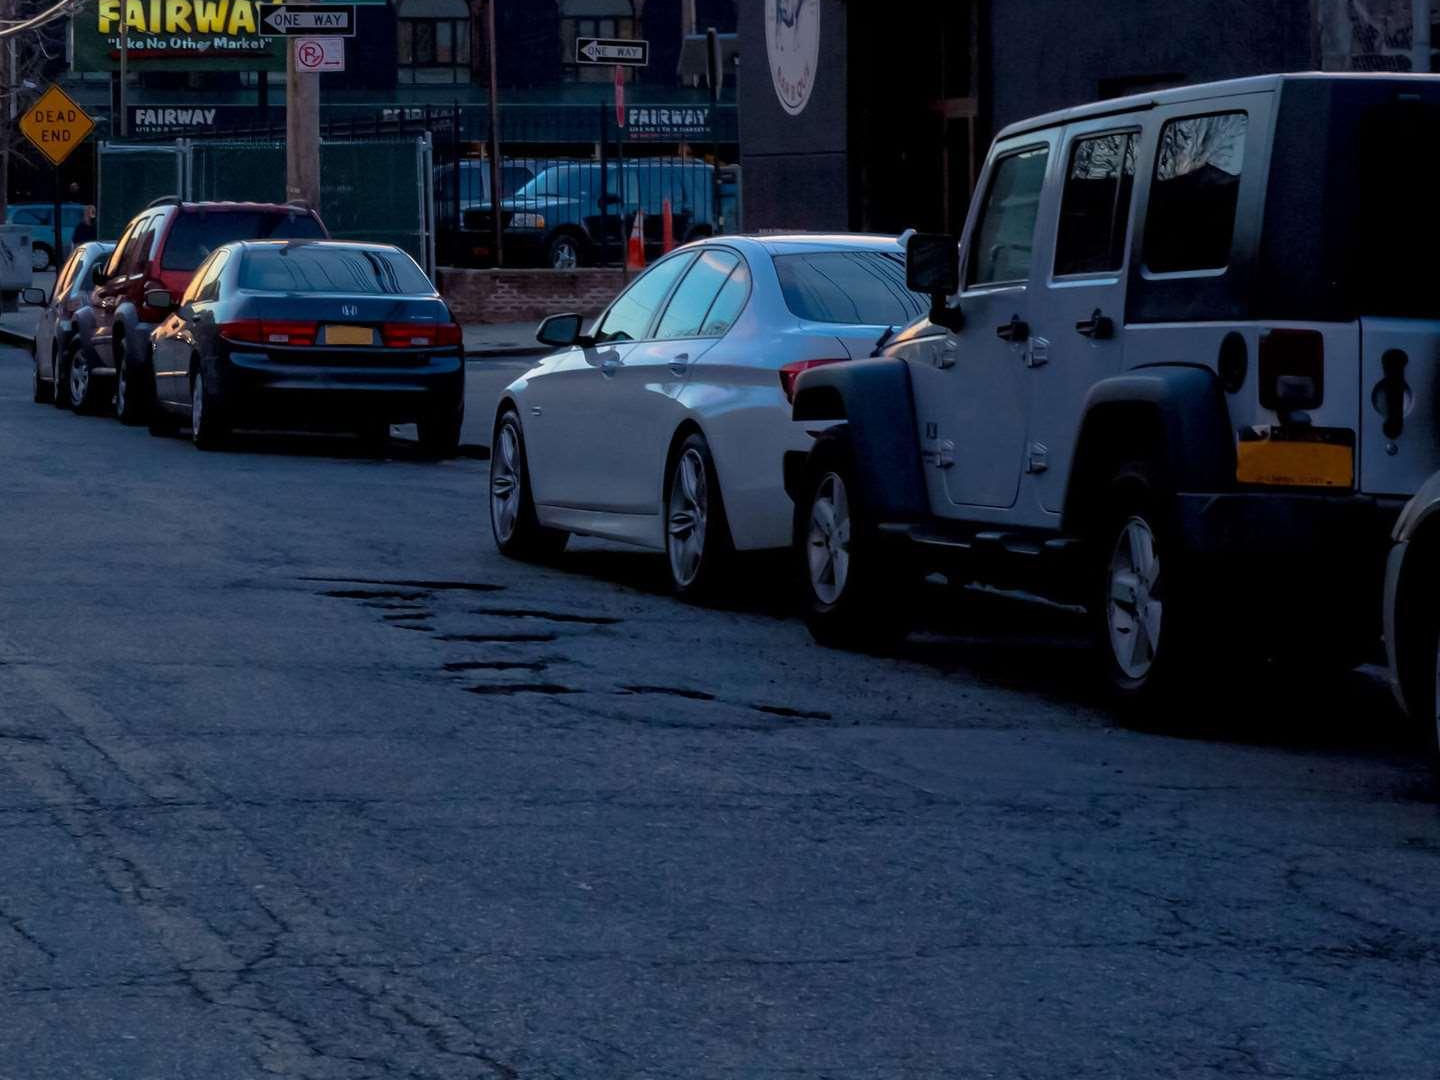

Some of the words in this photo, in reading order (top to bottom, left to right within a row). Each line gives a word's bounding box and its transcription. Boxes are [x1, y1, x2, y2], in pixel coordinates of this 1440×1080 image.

[274, 15, 300, 26] ONE
[314, 15, 342, 26] WAY
[108, 37, 144, 50] "Lke
[147, 38, 166, 50] No
[588, 46, 608, 57] ONE
[617, 47, 638, 57] WAY
[35, 110, 77, 124] DEAD
[136, 108, 216, 125] FAIRWAY
[629, 108, 709, 126] FAIRWAY
[42, 129, 71, 143] END
